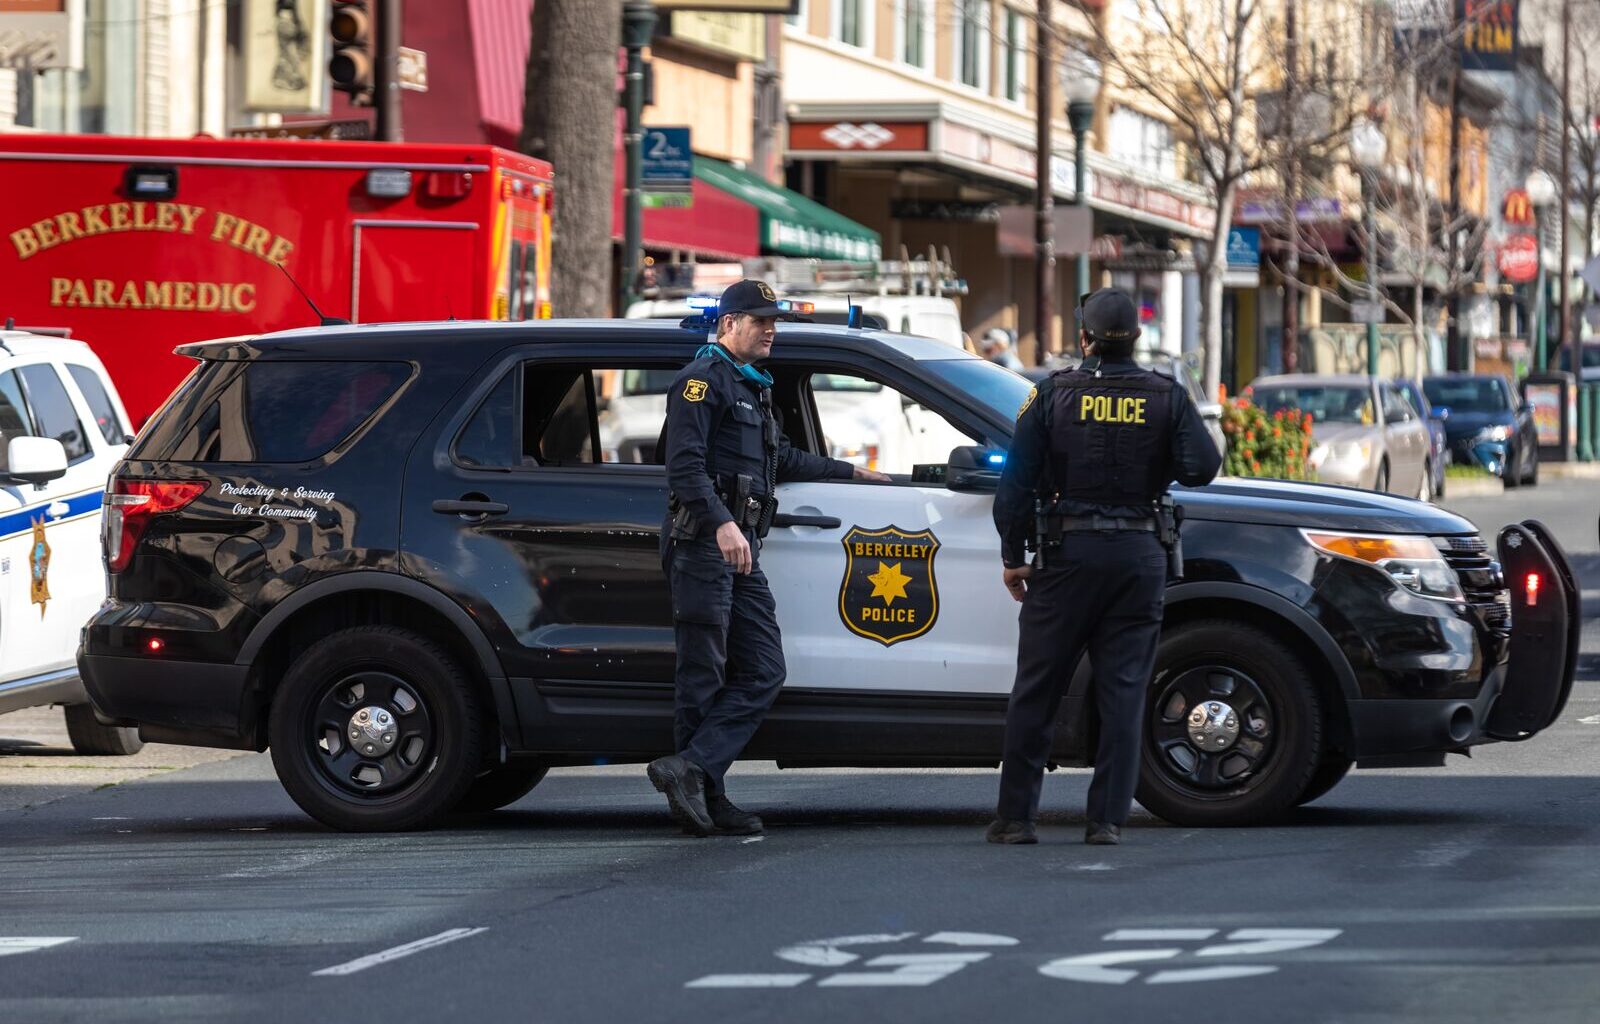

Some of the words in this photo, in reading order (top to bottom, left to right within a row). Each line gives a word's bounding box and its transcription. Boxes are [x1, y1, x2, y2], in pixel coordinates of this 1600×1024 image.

[1464, 22, 1513, 53] FILM
[648, 131, 667, 158] 2
[9, 201, 204, 260] BERKELEY
[210, 211, 294, 267] FIRE
[50, 277, 256, 312] PARAMEDIC
[1081, 395, 1147, 424] POLICE
[219, 482, 275, 501] Protecting
[281, 487, 289, 497] &
[293, 486, 336, 504] Serving
[232, 502, 253, 515] Our
[258, 503, 318, 523] Community
[855, 542, 928, 558] BERKELEY
[862, 607, 915, 622] POLICE
